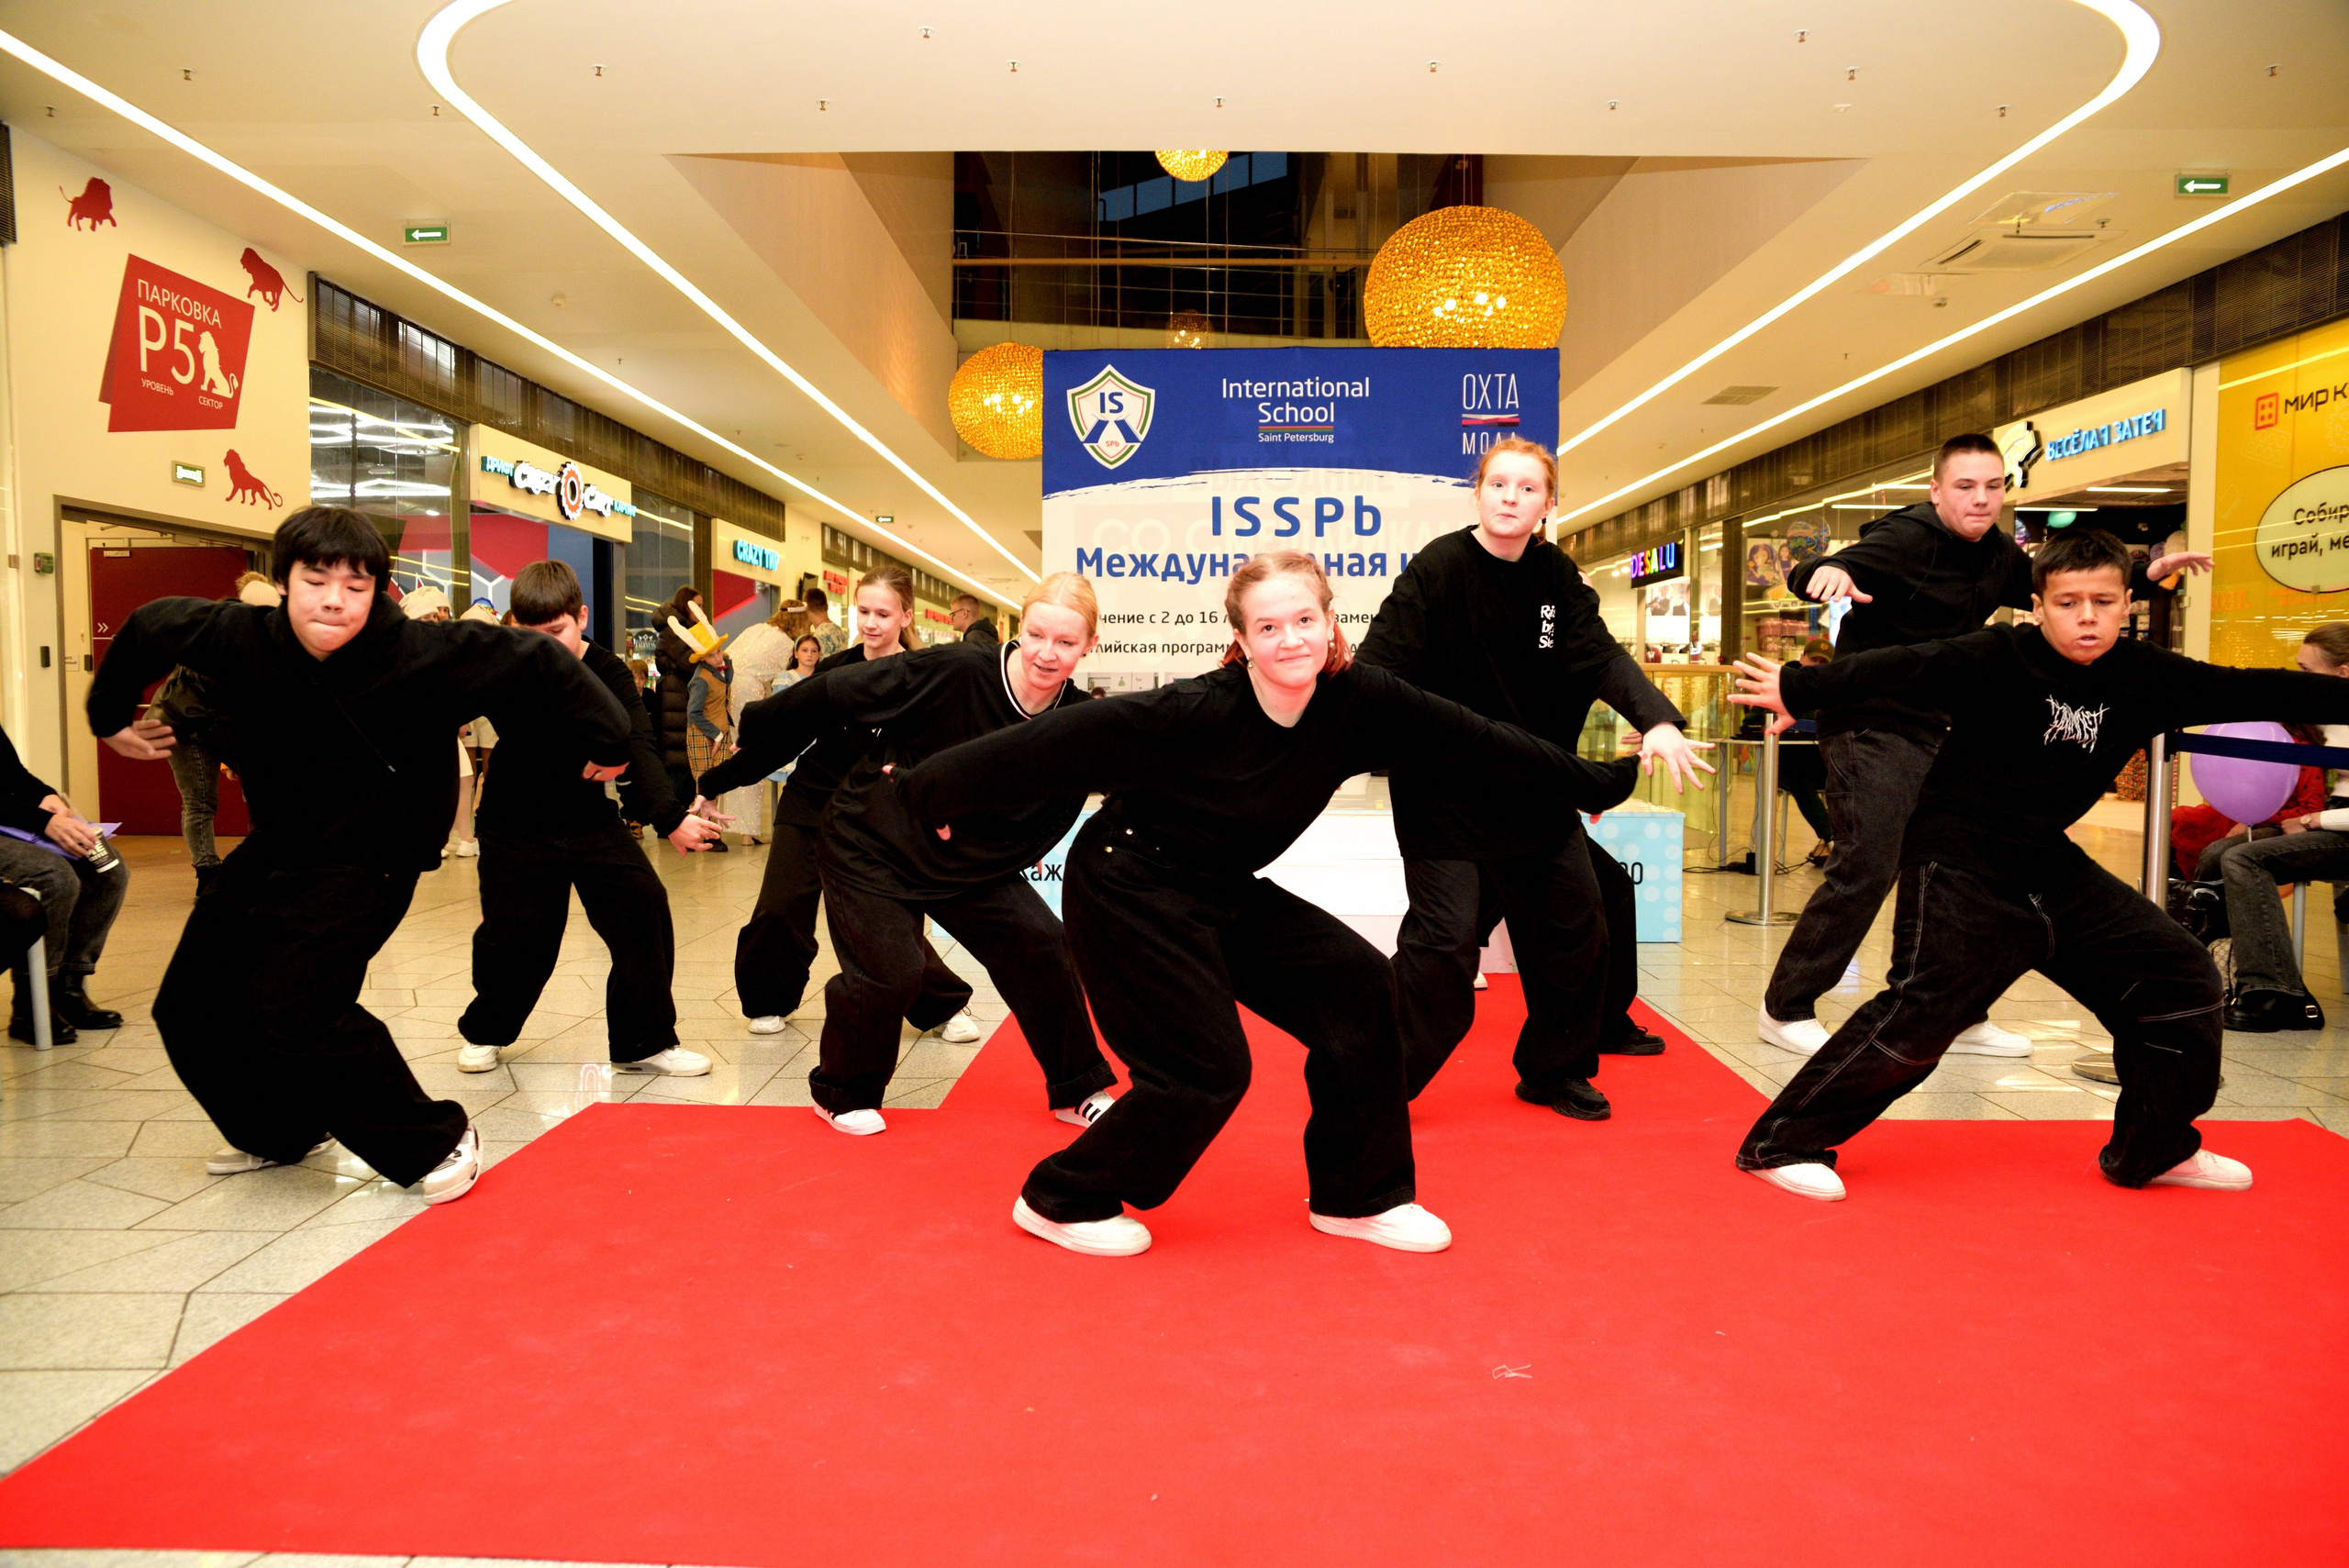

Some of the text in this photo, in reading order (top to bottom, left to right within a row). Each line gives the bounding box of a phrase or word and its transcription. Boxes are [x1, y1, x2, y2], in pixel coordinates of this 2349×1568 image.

[138, 278, 222, 329] ПАРКОВКА
[139, 305, 195, 384] P5
[140, 377, 174, 396] УРОВЕНЬ
[1222, 376, 1370, 398] International
[1463, 373, 1520, 410] ОХТА
[198, 395, 224, 410] СЕКТОР
[1099, 391, 1124, 414] IS
[1258, 401, 1334, 423] School
[1258, 432, 1334, 444] Saint Petersburg
[2045, 408, 2165, 462] ВЕСЁЛАЯ ЗАТЕЯ
[486, 455, 515, 477] ДРИФТ
[1212, 495, 1382, 537] ISSPb
[2294, 501, 2349, 526] Собир
[736, 539, 765, 567] CRAZY
[2271, 532, 2323, 561] играй,
[1076, 547, 1387, 584] Междунаная
[1631, 541, 1675, 580] DESALU
[1149, 614, 1156, 624] с
[1161, 611, 1170, 624] 2
[1174, 614, 1194, 626] до
[1199, 611, 1219, 624] 16
